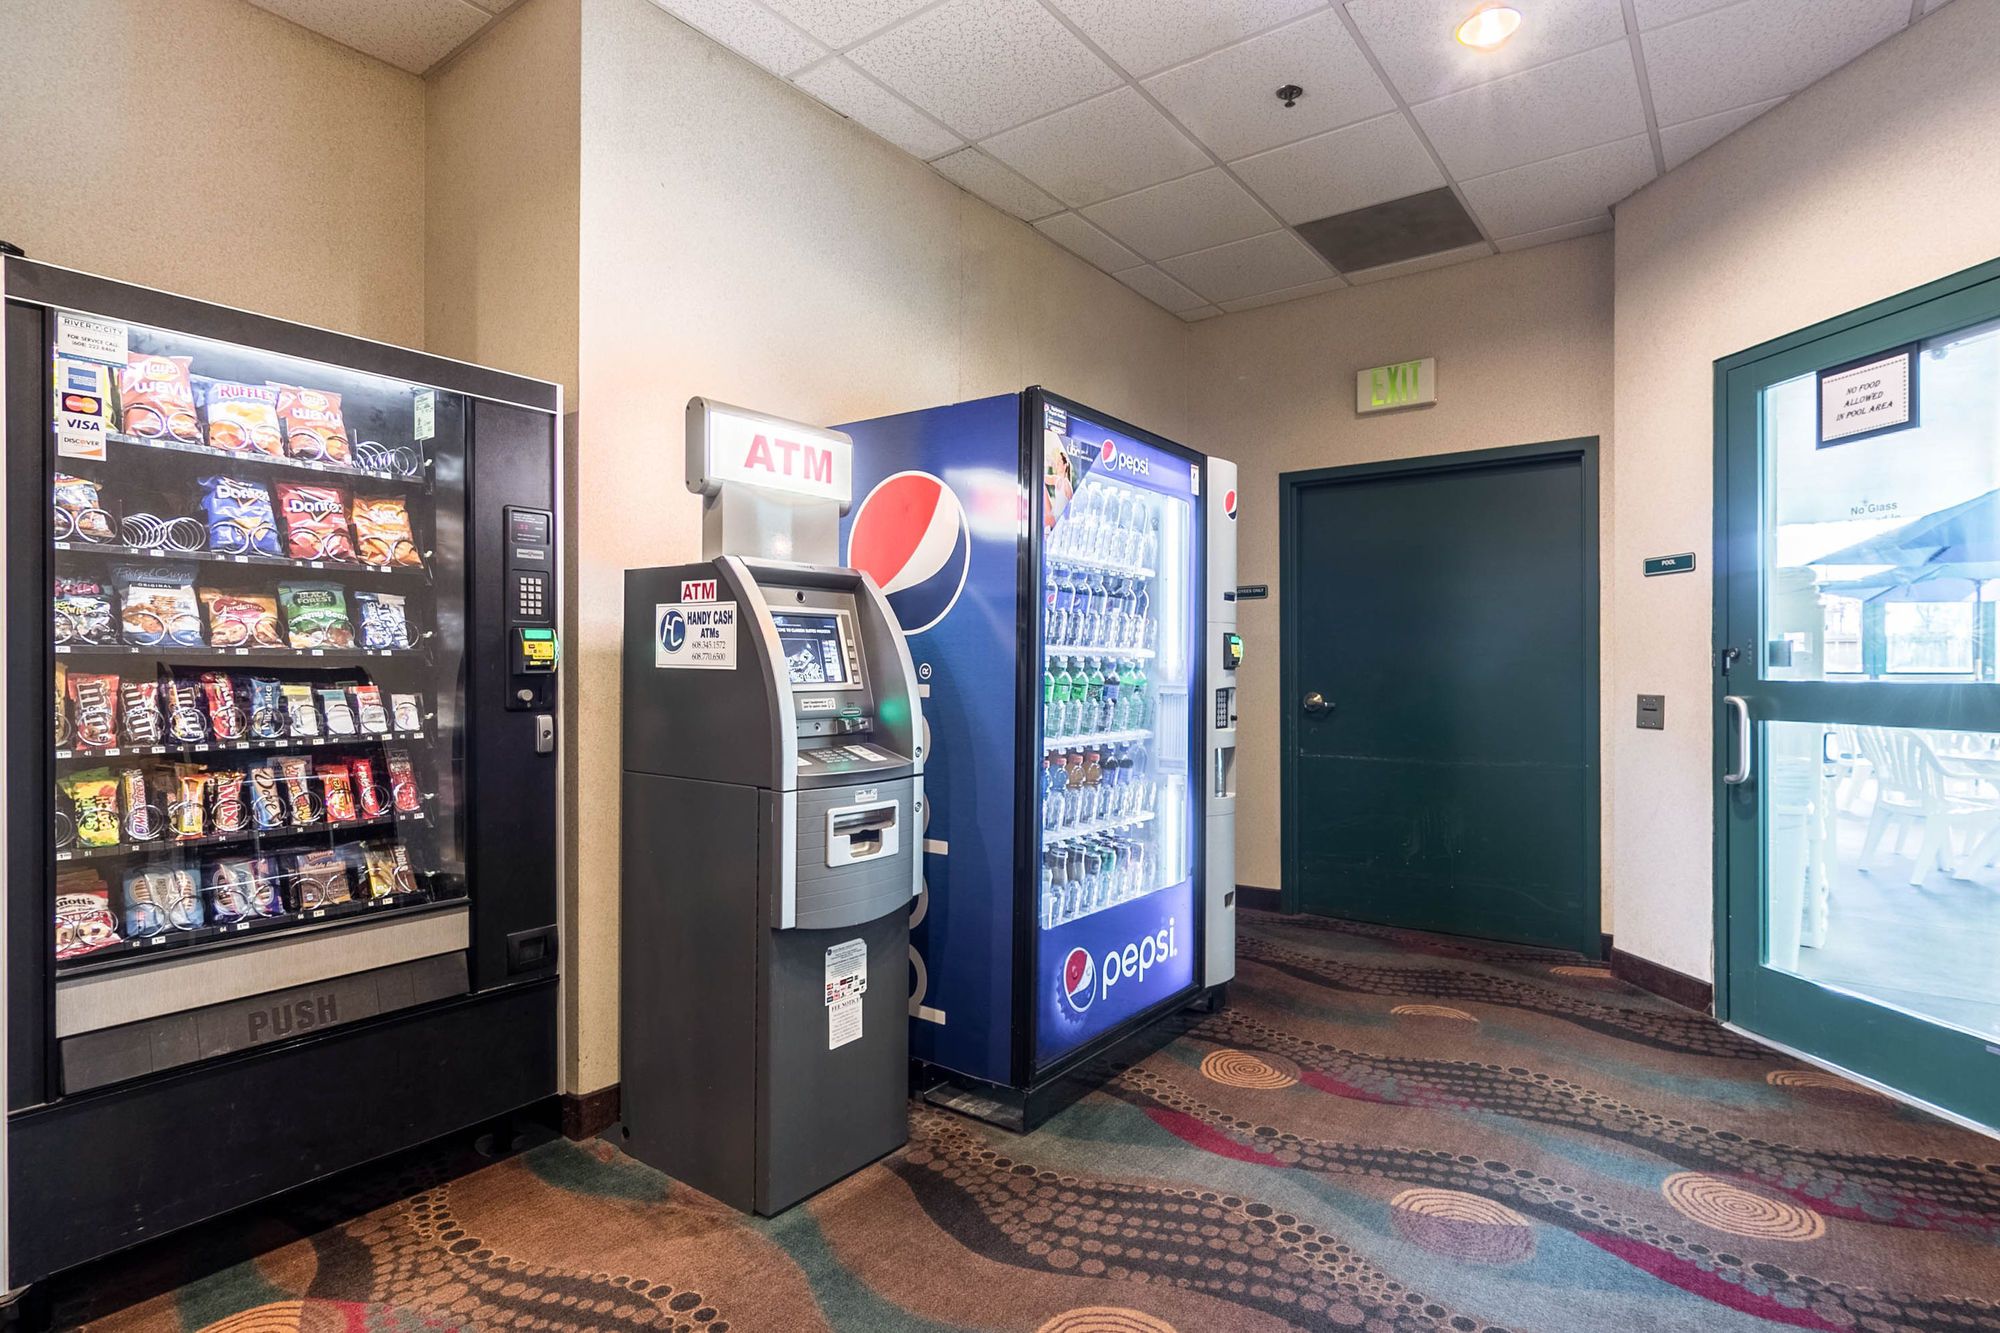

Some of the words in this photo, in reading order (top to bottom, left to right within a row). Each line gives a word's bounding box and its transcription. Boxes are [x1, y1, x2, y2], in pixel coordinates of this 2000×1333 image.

[103, 326, 123, 334] CITY
[1371, 362, 1421, 406] EXIT
[1846, 386, 1857, 395] NO
[1859, 380, 1881, 392] FOOD
[1843, 391, 1884, 407] ALLOWED
[1836, 412, 1846, 421] IN
[1846, 407, 1867, 419] POOL
[1868, 400, 1893, 413] AREA
[66, 419, 100, 431] VISA
[63, 437, 100, 446] DISCOVER
[744, 434, 833, 485] ATM
[1119, 452, 1150, 476] pepsi
[1850, 506, 1865, 516] No
[1868, 502, 1898, 513] Glass
[1661, 559, 1676, 567] POOL
[299, 590, 329, 598] BLACK
[683, 582, 715, 600] ATM
[297, 596, 332, 604] FOREST
[687, 611, 711, 625] HANDY
[713, 610, 733, 624] CASH
[700, 628, 719, 638] ATMs
[1103, 917, 1175, 1001] pepsi
[247, 994, 338, 1042] PUSH
